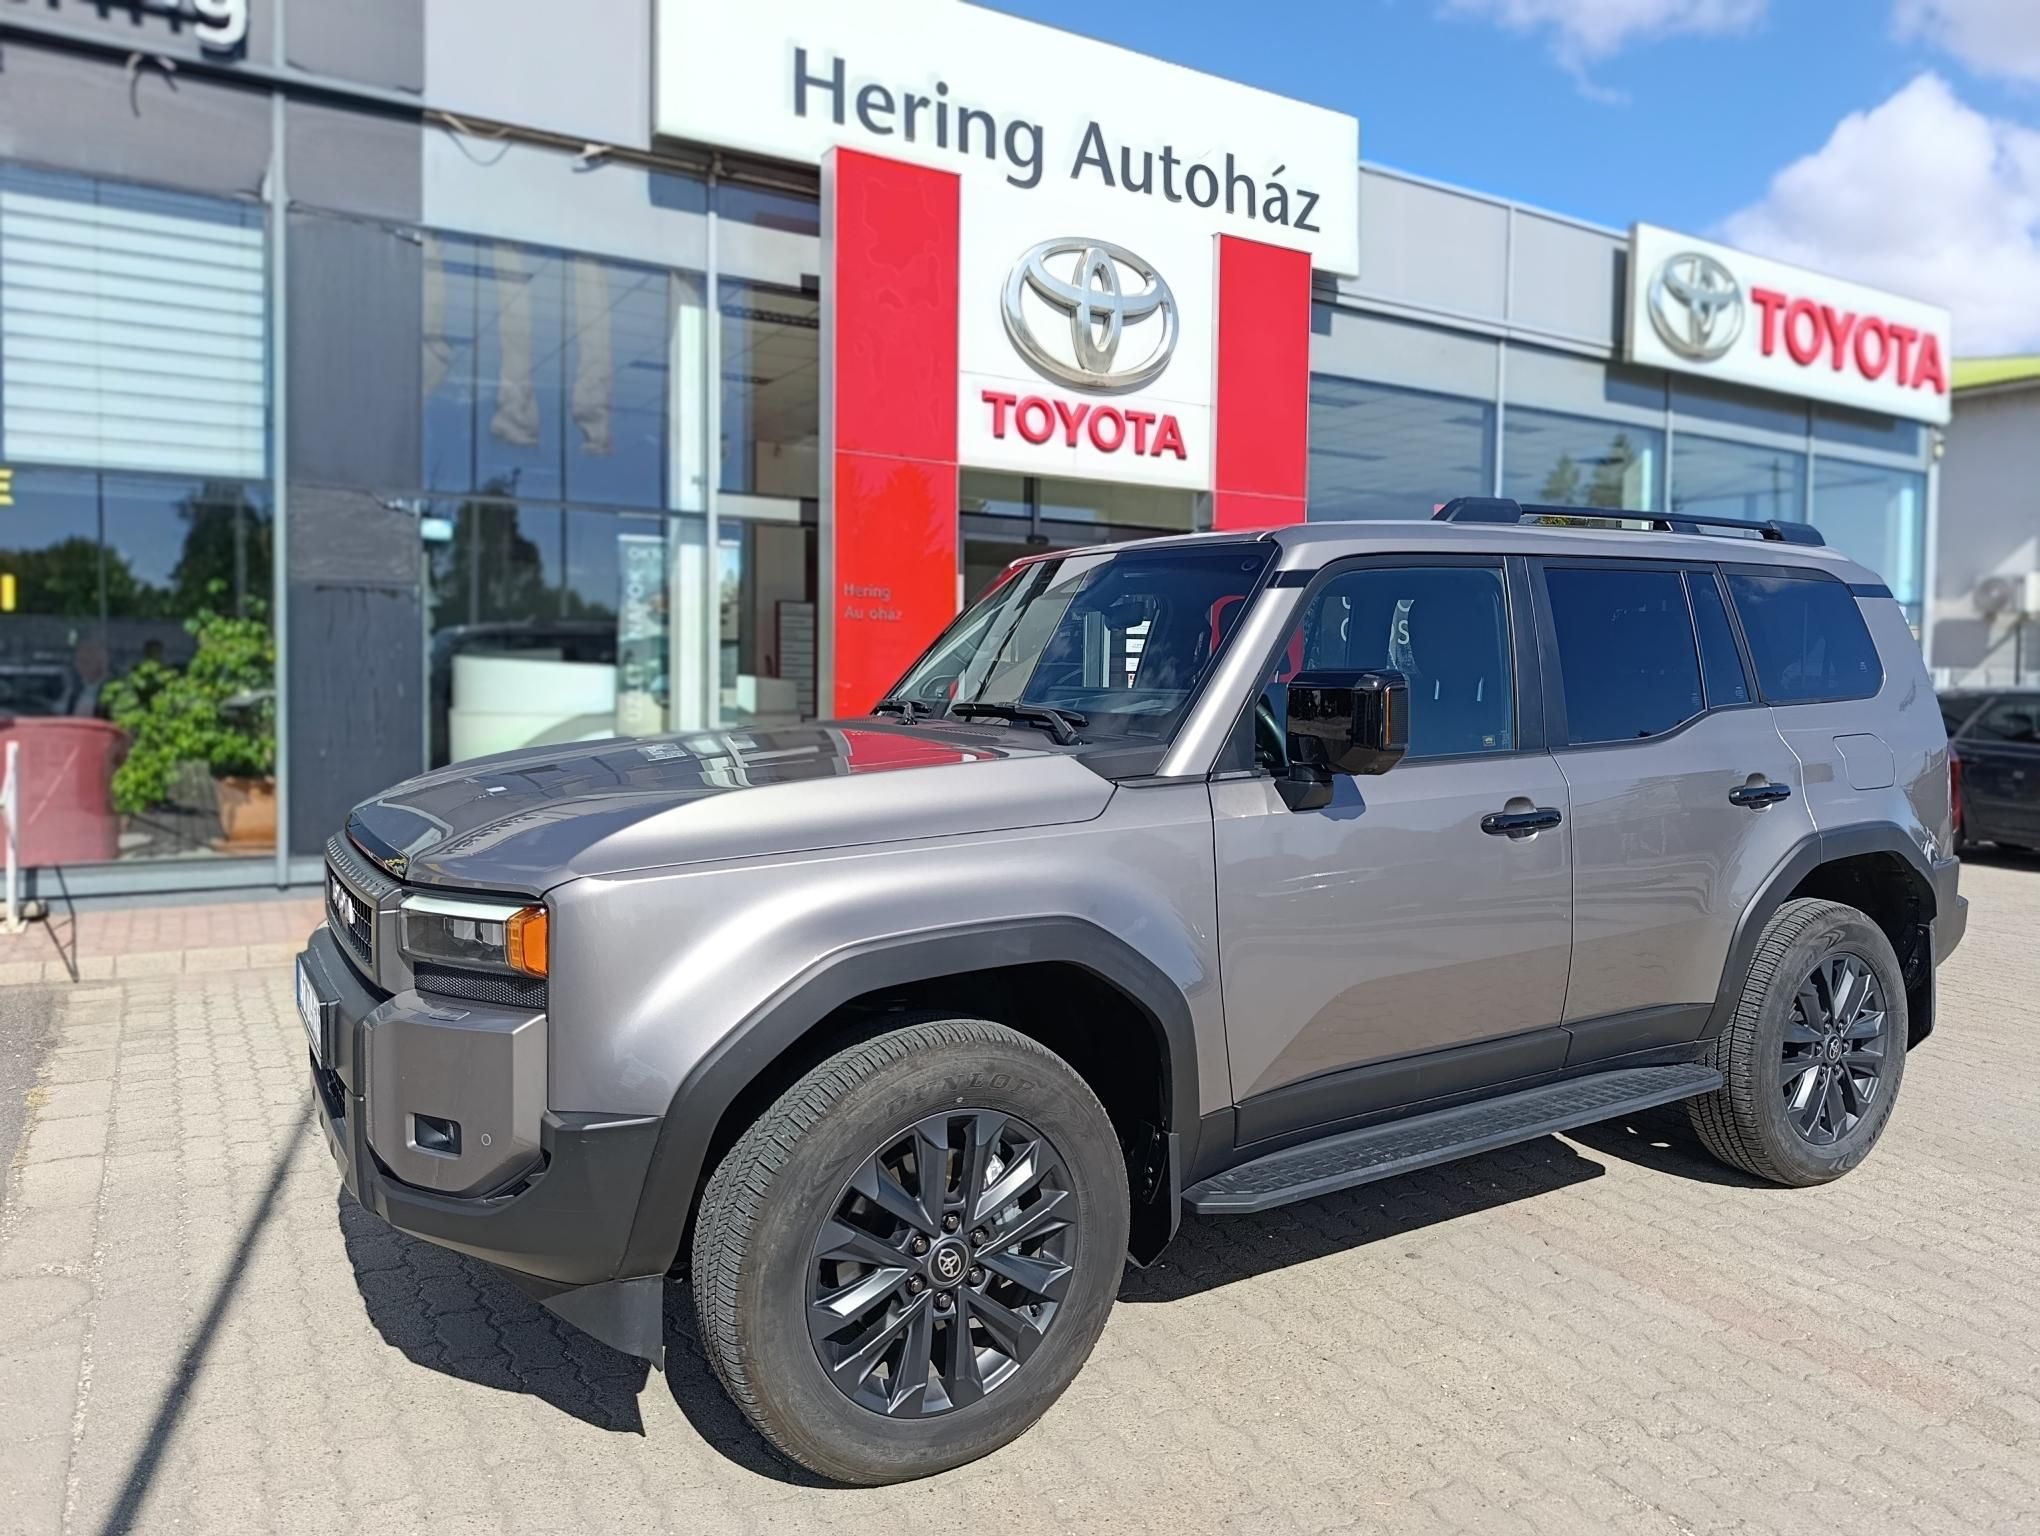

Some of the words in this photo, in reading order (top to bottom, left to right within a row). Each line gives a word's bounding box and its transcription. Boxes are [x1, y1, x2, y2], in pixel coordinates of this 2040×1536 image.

[794, 46, 1043, 189] Hering
[1070, 120, 1320, 232] Autoház
[1751, 287, 1945, 395] TOYOTA
[981, 389, 1187, 460] TOYOTA
[843, 582, 892, 602] Hering
[843, 604, 903, 621] Auoház
